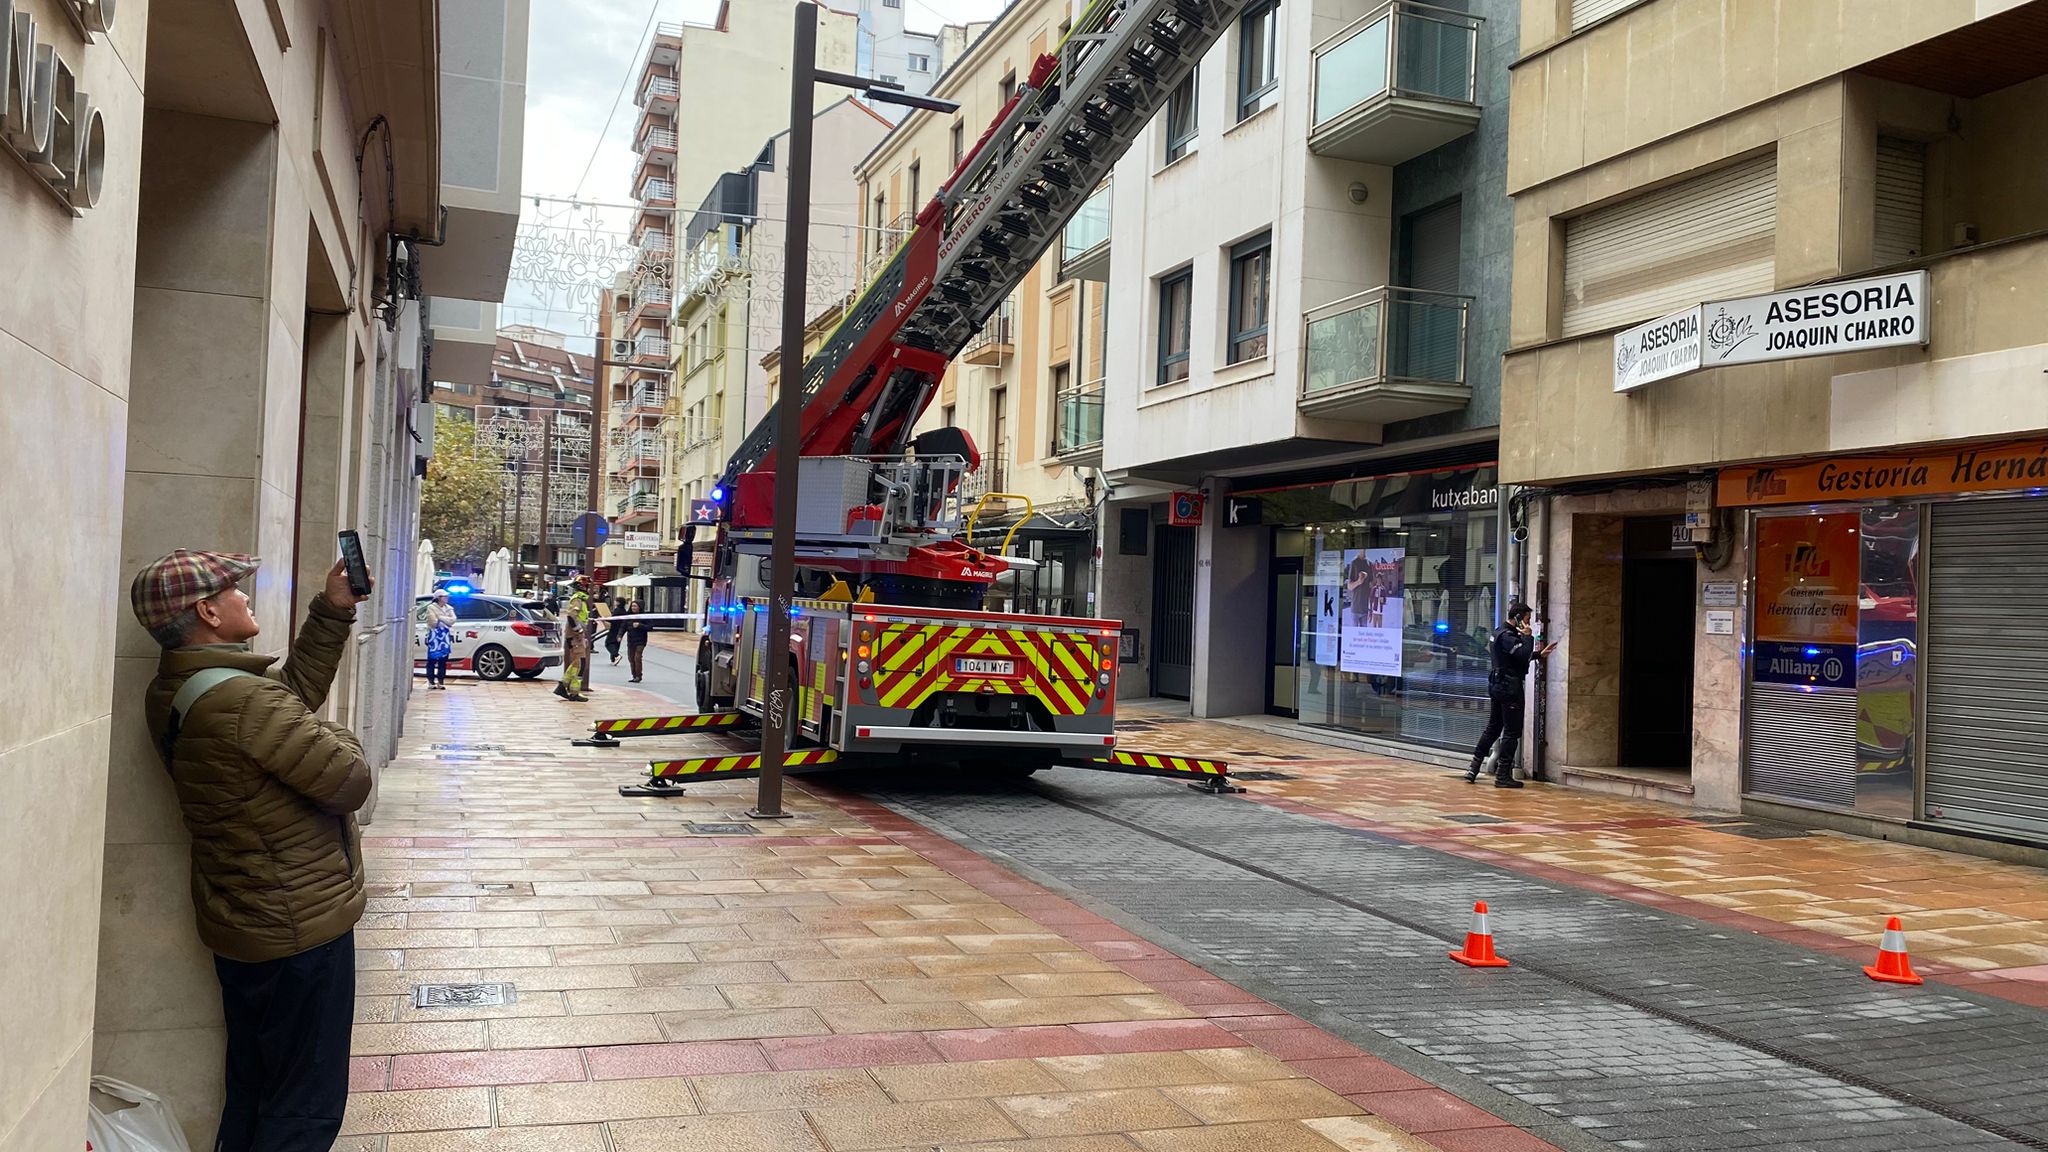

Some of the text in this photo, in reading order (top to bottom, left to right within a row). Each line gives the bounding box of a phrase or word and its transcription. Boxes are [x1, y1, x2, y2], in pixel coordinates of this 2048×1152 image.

[939, 124, 1048, 260] BOMBEROS Ayto. de León
[905, 275, 928, 304] MAGIRUS
[1765, 283, 1915, 325] ASESORIA
[1640, 314, 1698, 354] ASESORIA
[1765, 315, 1915, 351] JOAQUIN CHARRO
[1639, 343, 1698, 377] JOAQUIN CHARRO
[1818, 458, 1929, 492] Gestoría
[1229, 499, 1238, 524] k
[1673, 526, 1689, 541] 40
[1323, 589, 1335, 618] k
[1831, 603, 1849, 617] Gil
[963, 661, 1010, 673] 1041 MYF
[1769, 657, 1821, 676] Allianz
